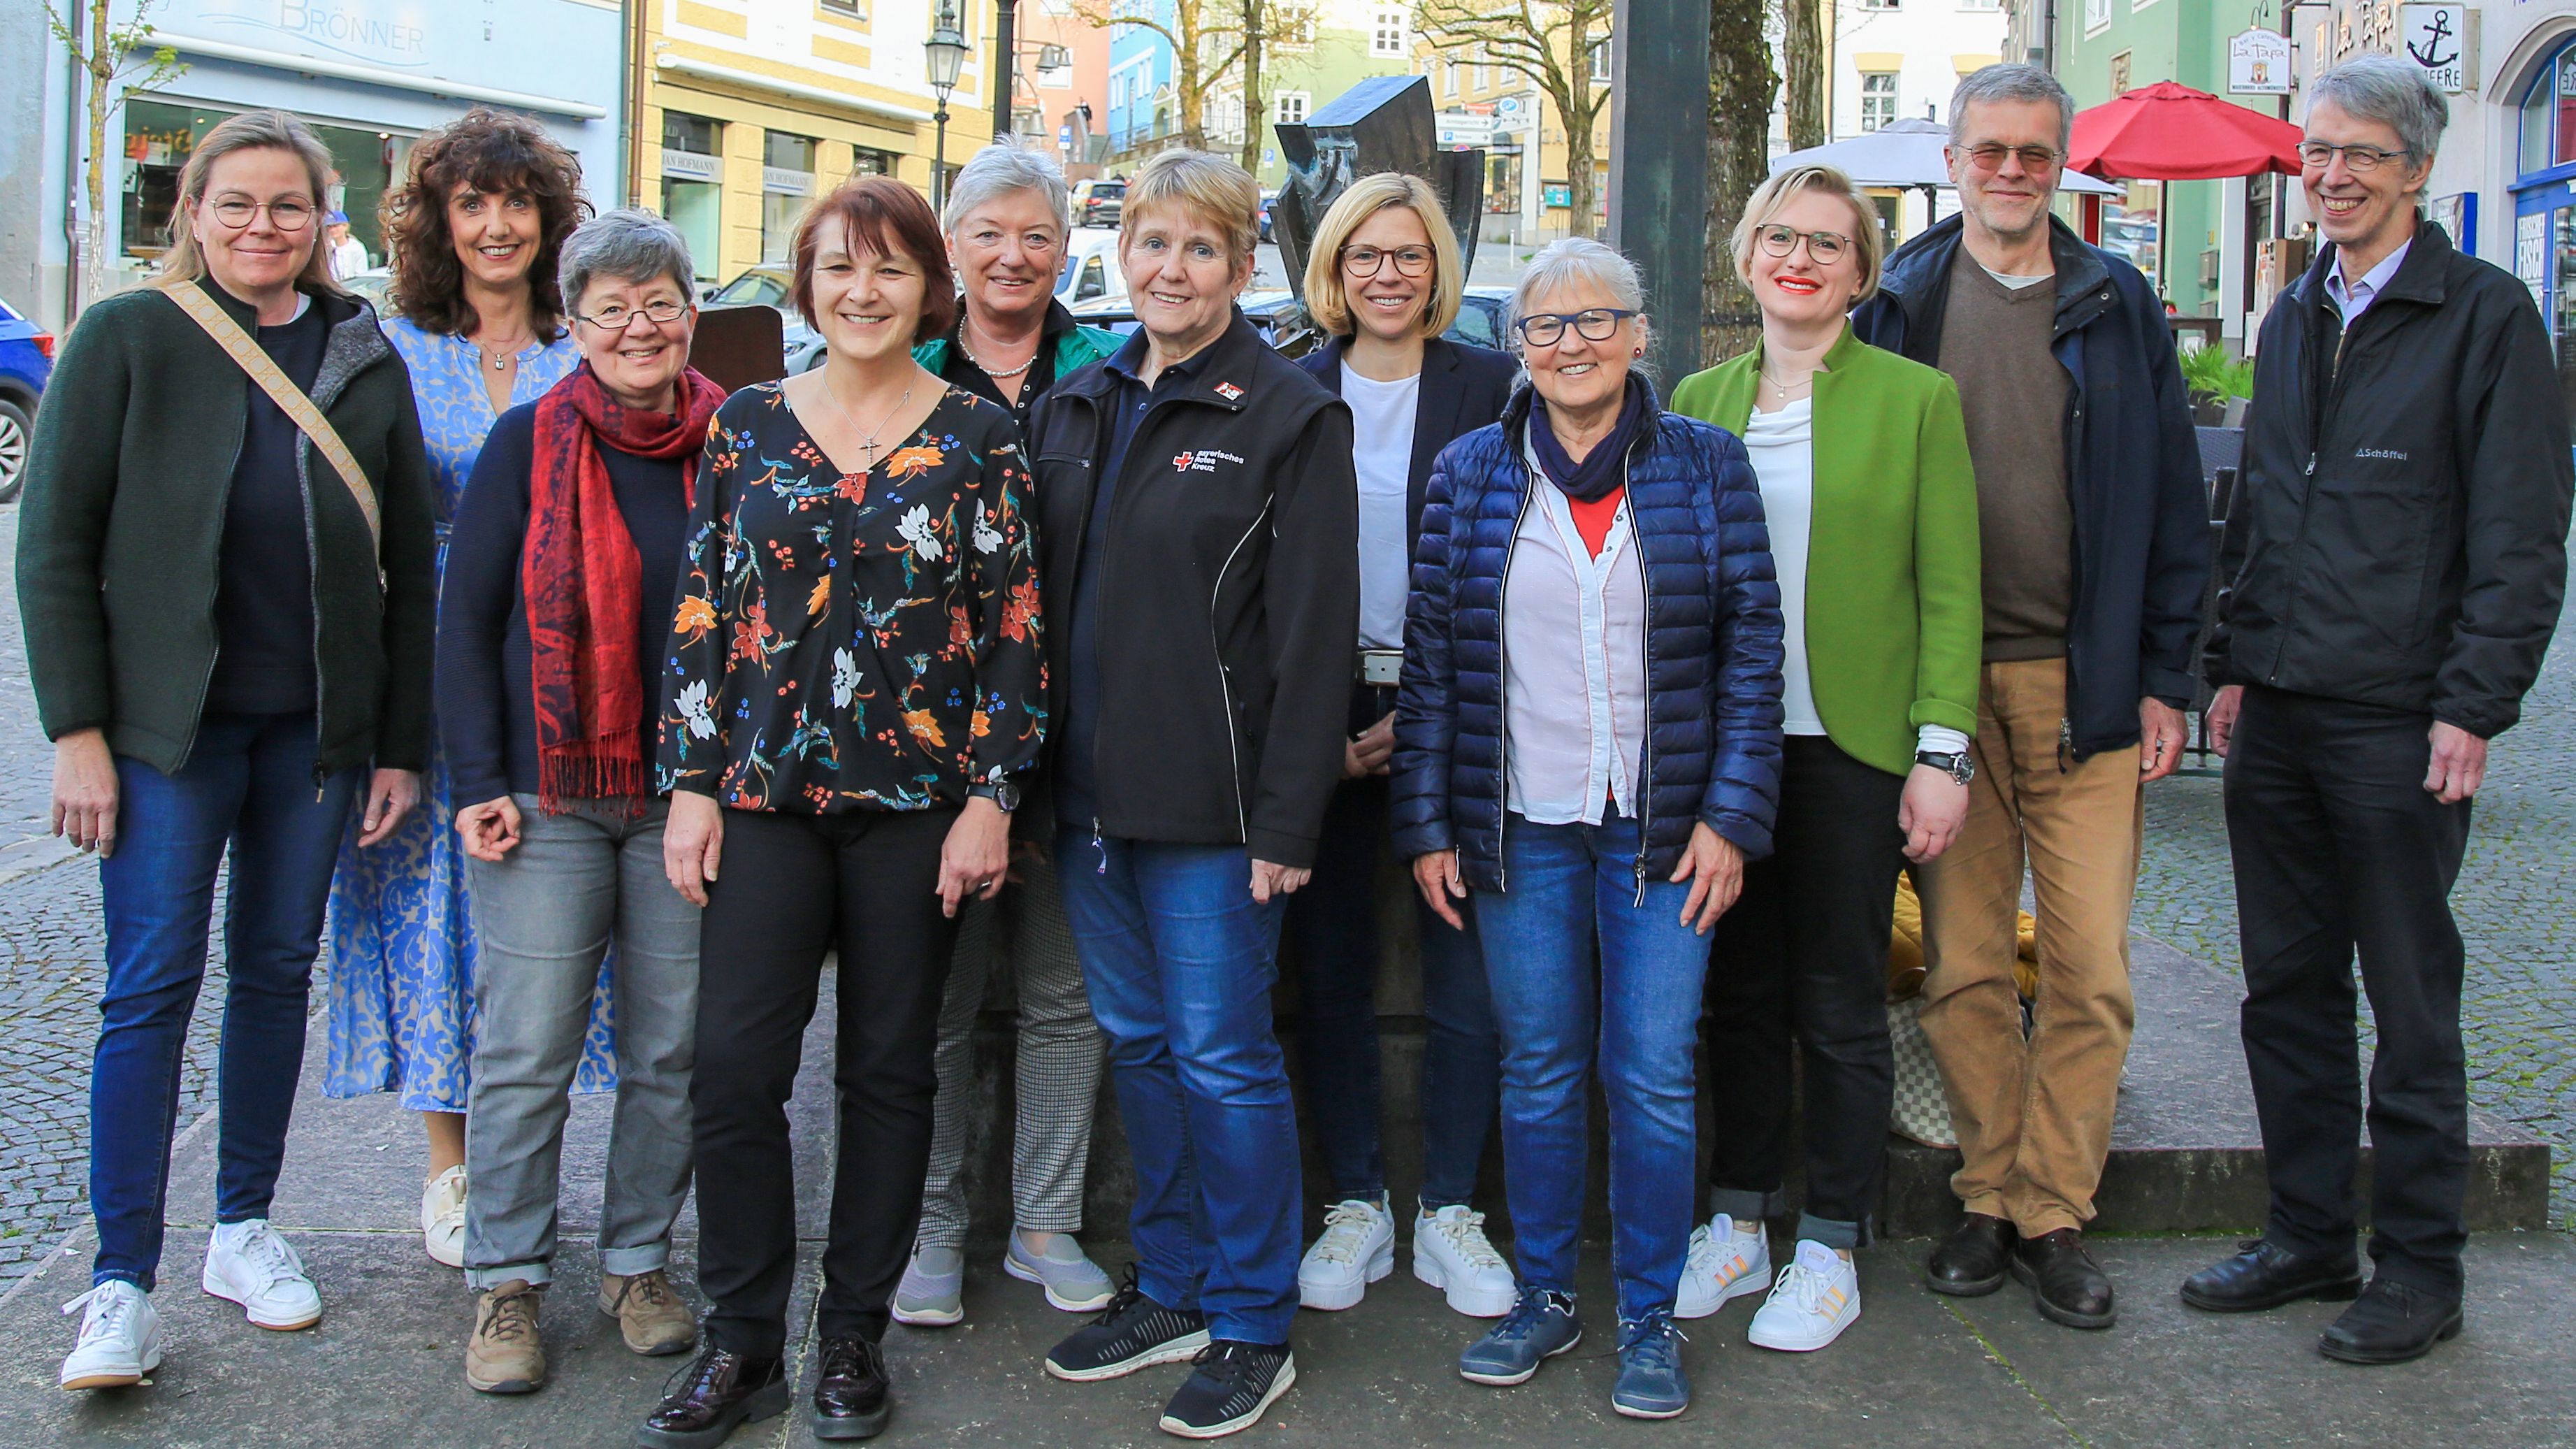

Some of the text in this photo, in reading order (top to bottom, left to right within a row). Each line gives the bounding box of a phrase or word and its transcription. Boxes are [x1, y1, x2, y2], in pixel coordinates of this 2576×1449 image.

[280, 0, 424, 54] BRÖNNER
[2233, 43, 2287, 60] La Tapa
[678, 157, 715, 172] HOFMANN
[2519, 238, 2545, 280] FISCH
[1194, 456, 1216, 465] Rotes
[2365, 448, 2408, 461] Schöffel
[1191, 463, 1215, 473] Kreuz
